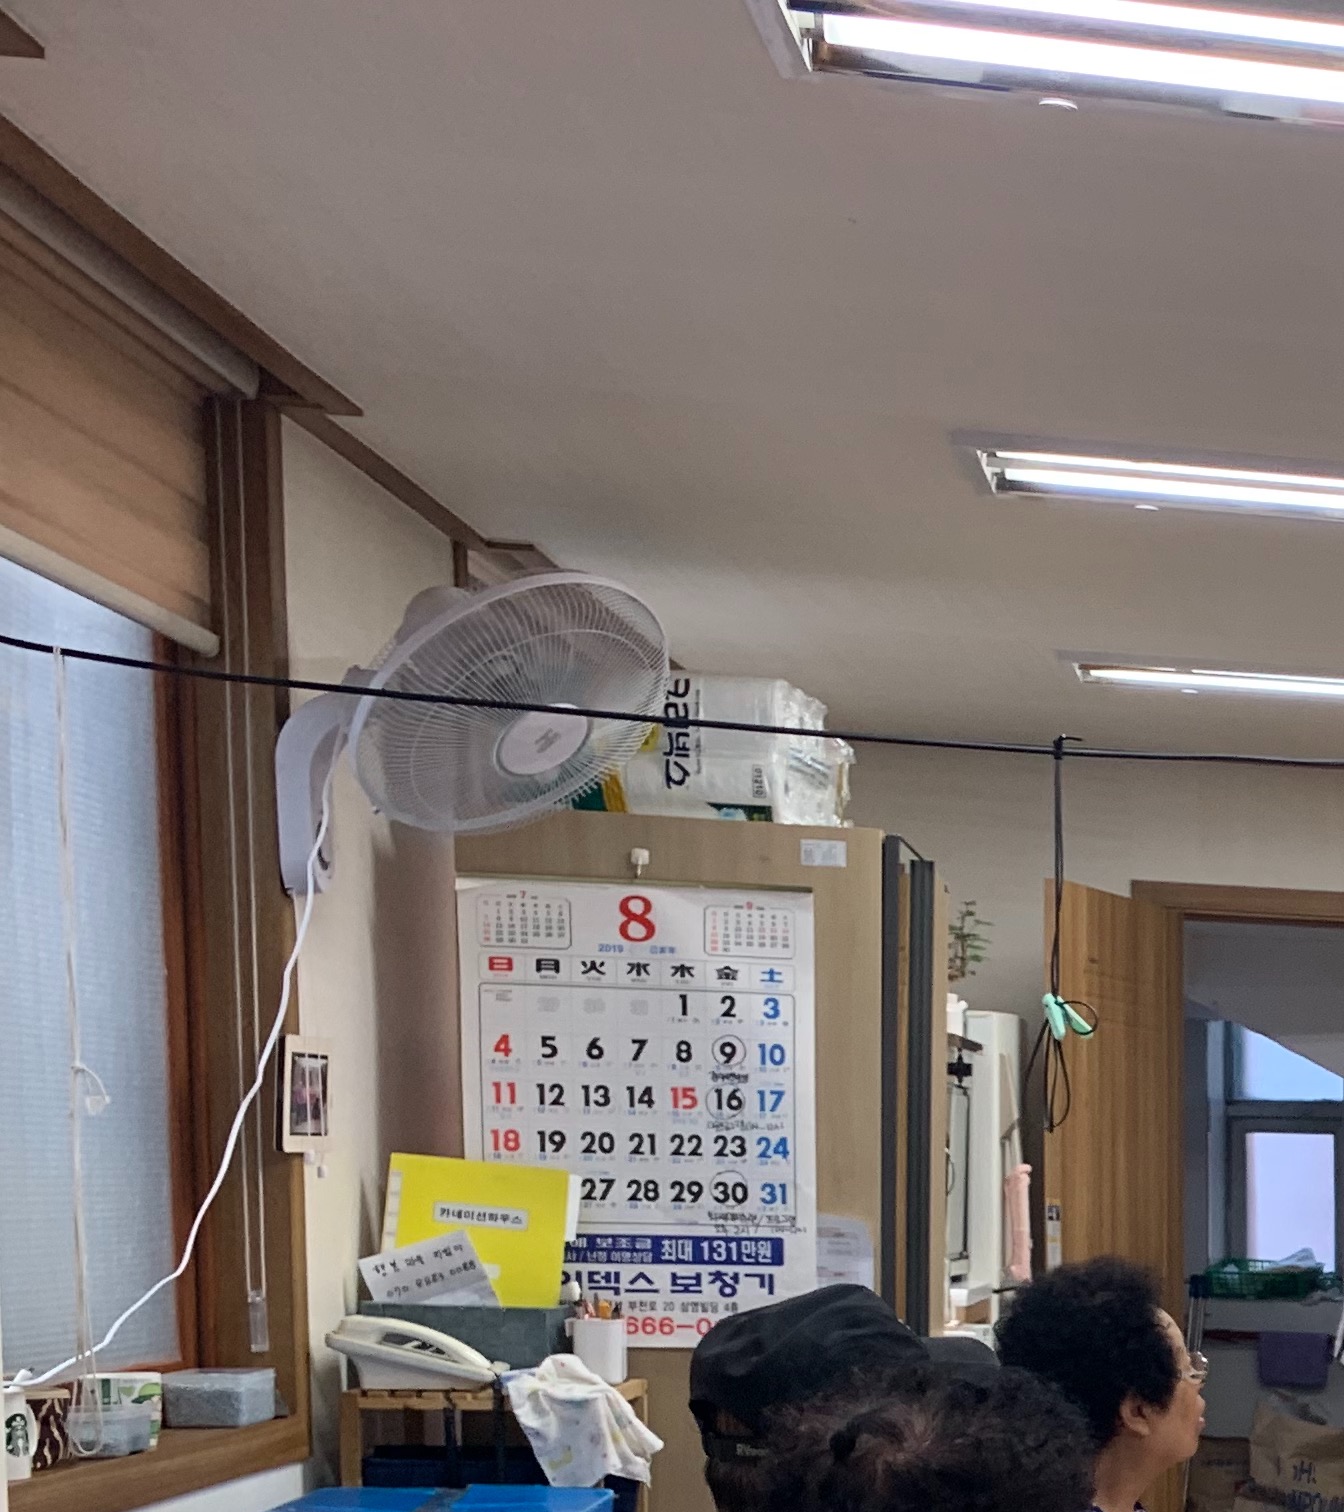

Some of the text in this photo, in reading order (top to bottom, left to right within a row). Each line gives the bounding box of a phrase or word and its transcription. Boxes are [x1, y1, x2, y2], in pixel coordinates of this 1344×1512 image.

[617, 894, 656, 942] 8
[597, 943, 624, 955] 2019
[488, 956, 784, 983] 日 月 火 水 木 金 土
[679, 994, 781, 1020] 1 2 3
[493, 1034, 786, 1066] 4 5 6 7 8 9 10
[492, 1081, 786, 1113] 11 12 13 14 15 16 17
[490, 1129, 791, 1160] 18 19 20 21 22 23 24
[581, 1178, 787, 1205] 27 28 29 30 31
[660, 1238, 773, 1264] 최대 131만원
[669, 1270, 775, 1298] 보청기
[628, 1301, 658, 1312] 부천로
[663, 1302, 675, 1312] 20
[626, 1316, 713, 1336] 666-0
